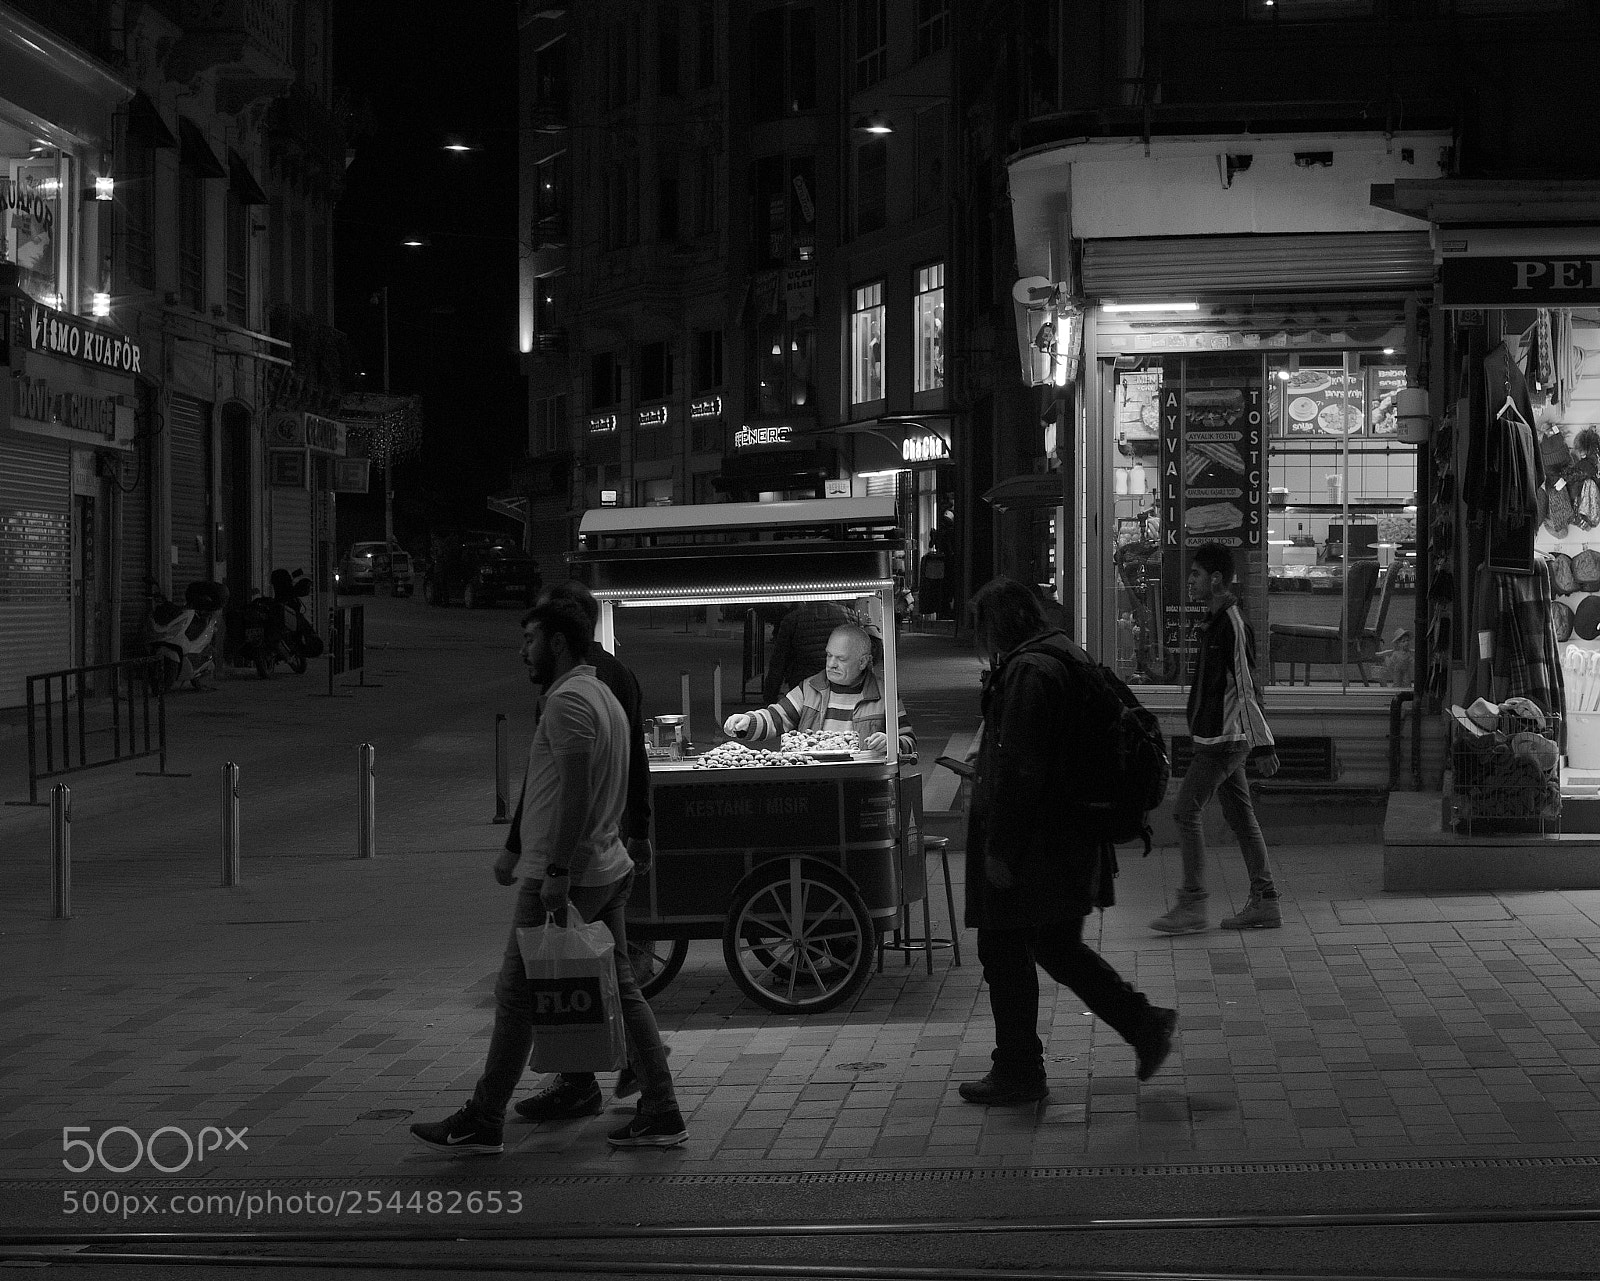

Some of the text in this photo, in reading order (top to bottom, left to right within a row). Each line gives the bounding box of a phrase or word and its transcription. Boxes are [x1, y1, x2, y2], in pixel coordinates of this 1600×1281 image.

[84, 331, 141, 373] KUAFÖR
[1166, 392, 1178, 545] AYVALIK
[1248, 391, 1261, 545] TOSTÇUSU
[685, 798, 753, 817] KESTANE
[535, 989, 592, 1014] FLO
